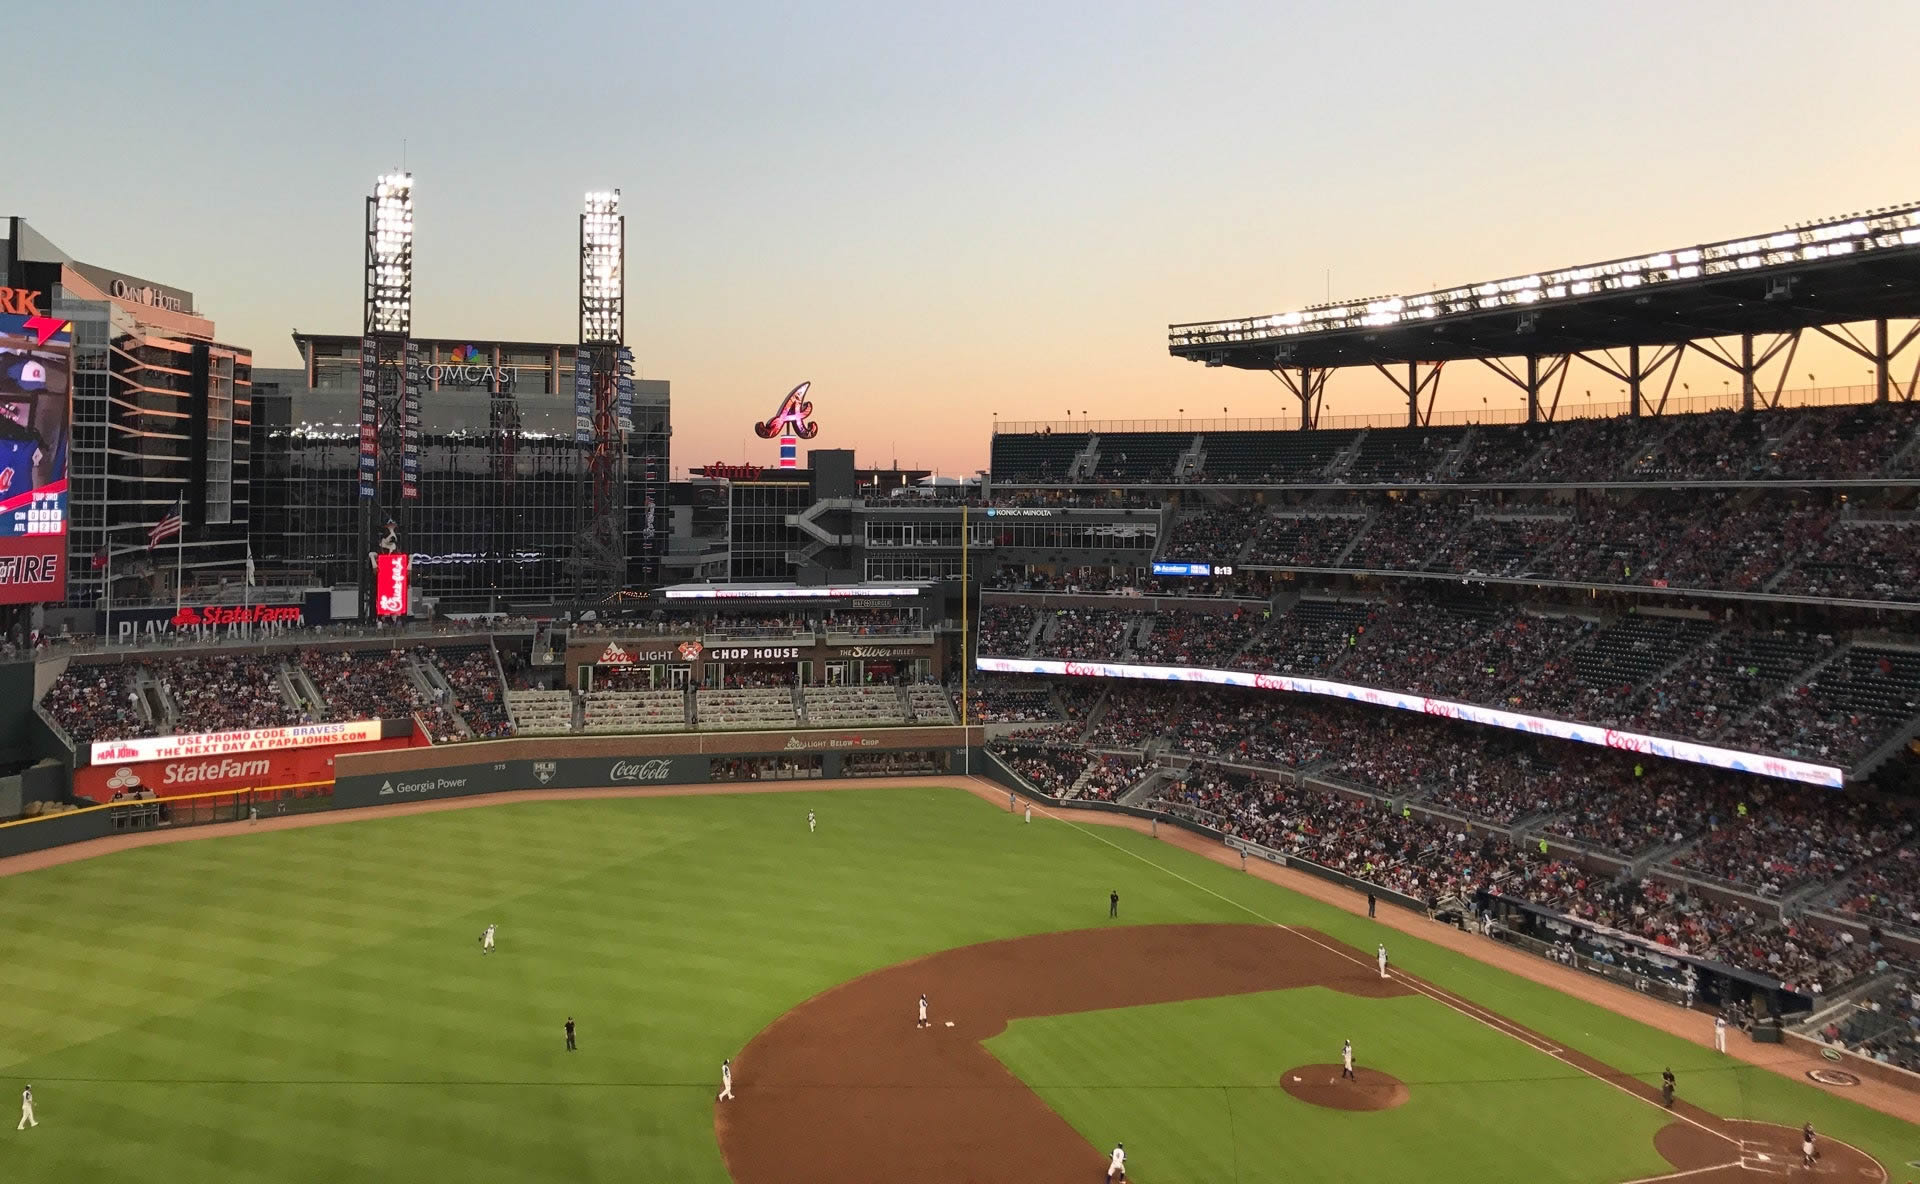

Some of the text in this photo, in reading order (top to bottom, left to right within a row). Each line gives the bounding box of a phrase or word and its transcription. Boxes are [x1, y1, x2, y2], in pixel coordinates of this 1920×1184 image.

[115, 279, 143, 303] OMNI
[0, 286, 42, 317] RK
[420, 364, 518, 382] OMCAST
[703, 461, 764, 482] xfinity
[31, 502, 37, 510] R
[14, 512, 26, 521] CIN
[14, 523, 26, 532] ATL
[600, 648, 673, 662] Coors LIGHT
[712, 648, 799, 659] CHOP HOUSE
[852, 646, 891, 657] Silver
[892, 648, 914, 656] BULLET
[156, 732, 367, 757] THE NEXT DAY AT PAPAJOHNS.COM
[177, 736, 203, 746] USE
[206, 732, 251, 744] PROMO
[807, 740, 827, 748] LIGHT
[830, 739, 853, 747] BELOW
[861, 738, 879, 746] CHOP
[397, 778, 467, 793] Georgia Power
